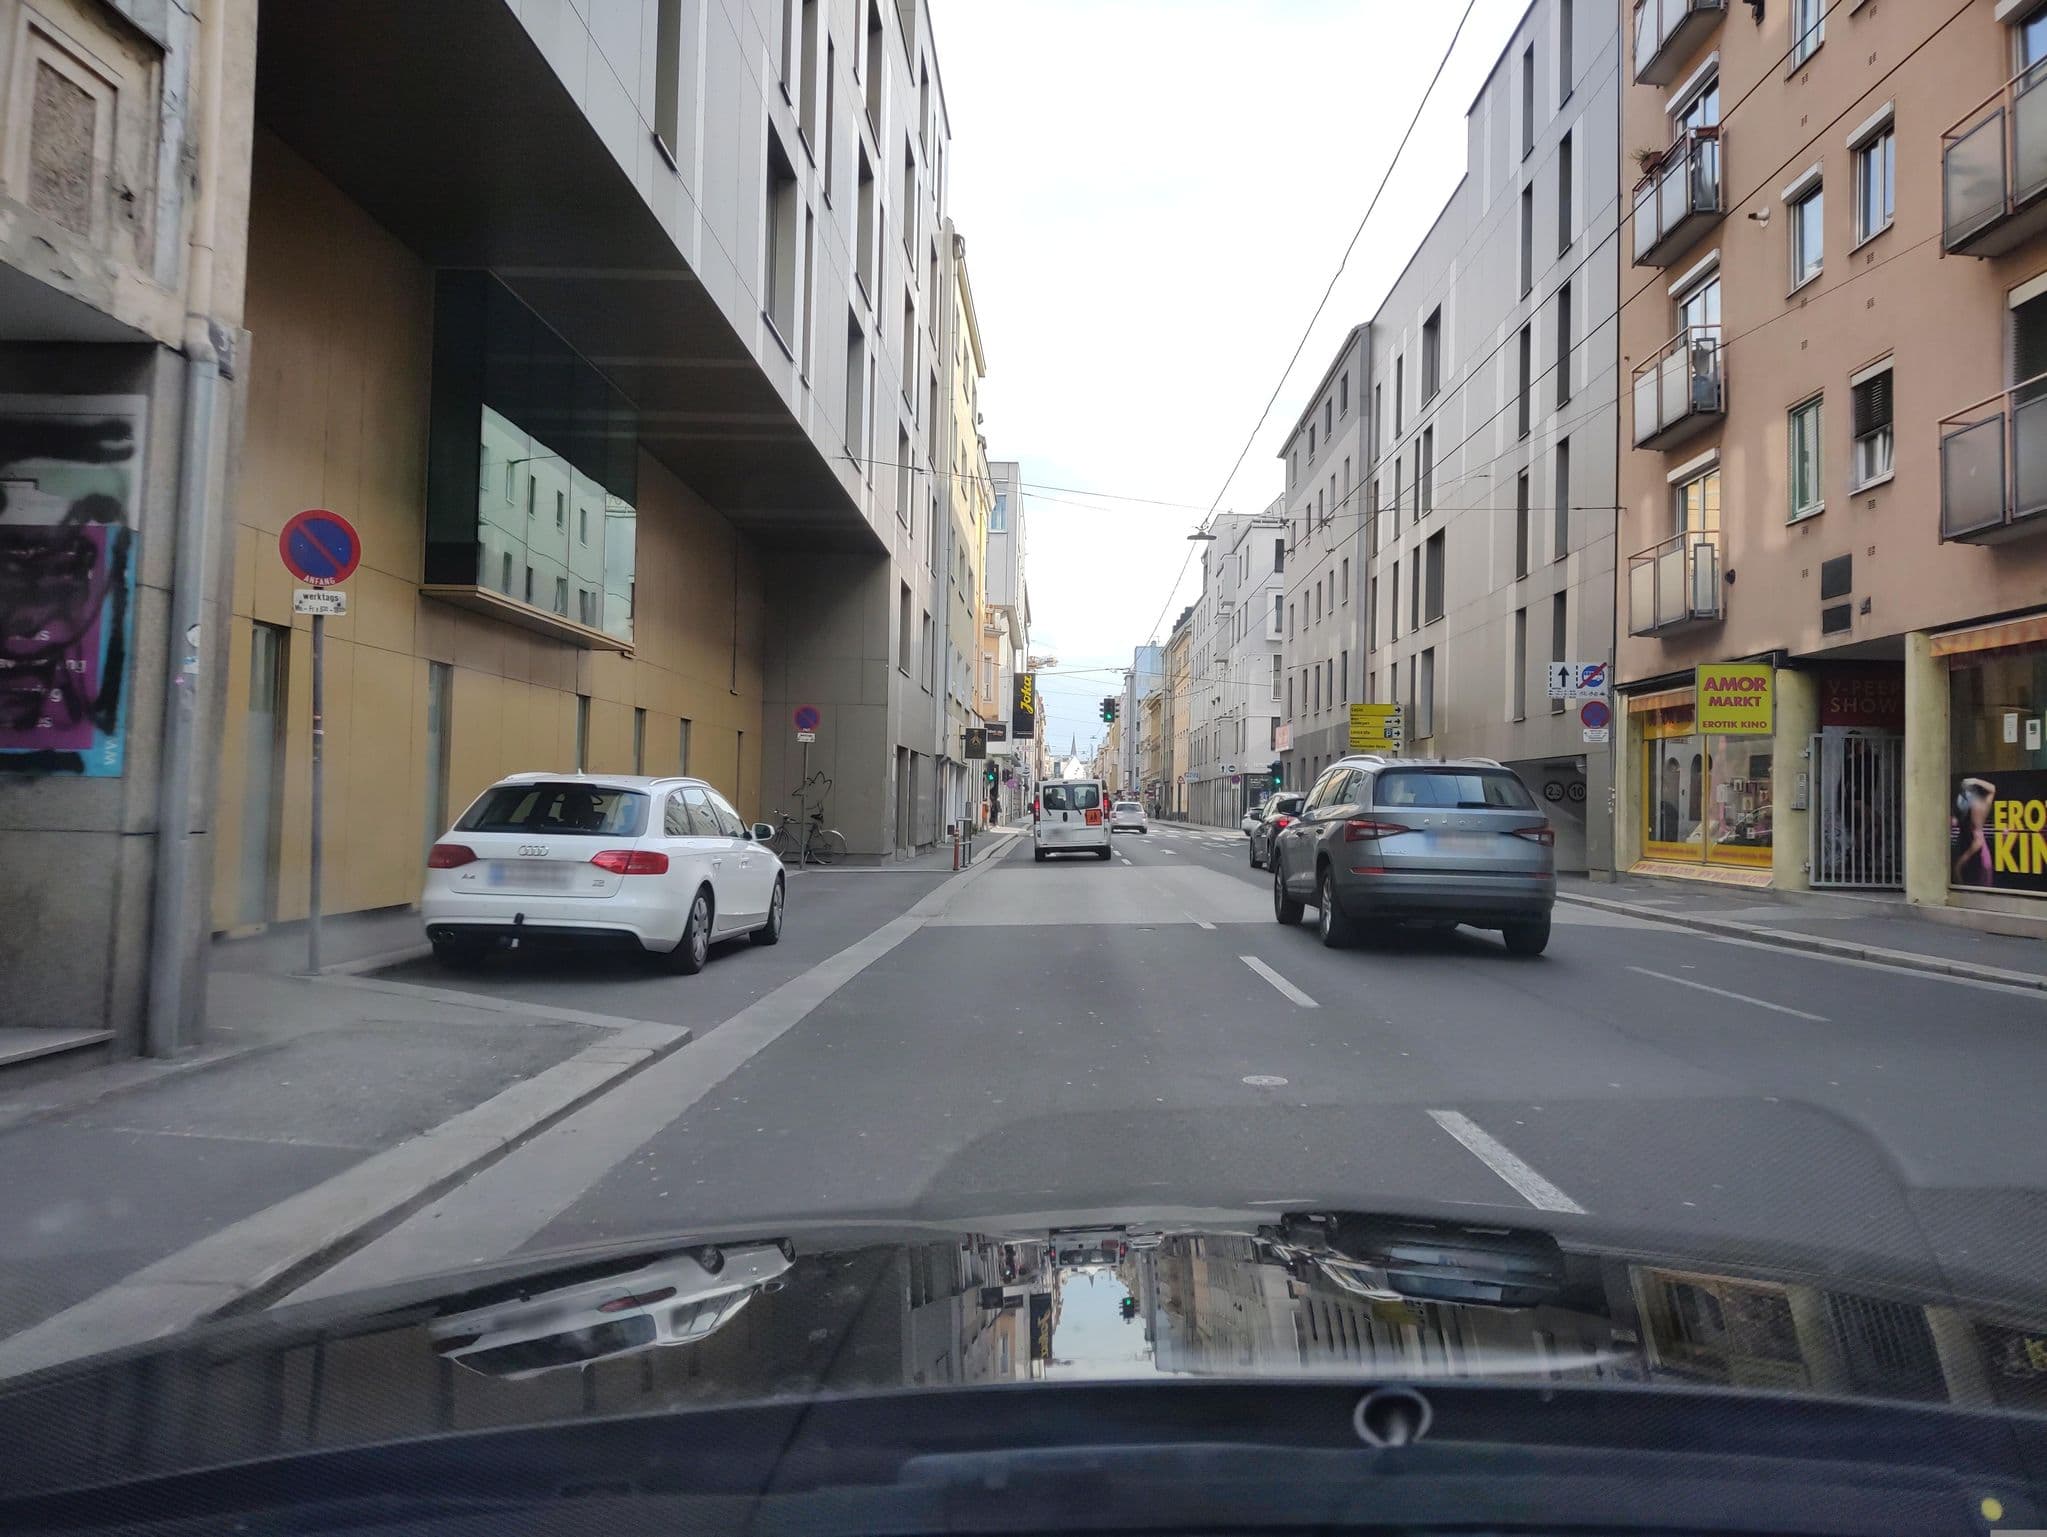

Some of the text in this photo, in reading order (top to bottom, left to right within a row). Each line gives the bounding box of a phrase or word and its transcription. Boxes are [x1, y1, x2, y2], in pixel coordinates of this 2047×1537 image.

[303, 575, 336, 586] ANFANG
[303, 592, 339, 602] werktags
[1703, 676, 1768, 692] AMOR
[1020, 675, 1034, 714] Joka
[1708, 696, 1762, 707] MARKT
[1830, 697, 1897, 713] SHOW
[1702, 720, 1767, 729] EROTIK KINO
[1570, 786, 1584, 798] 10
